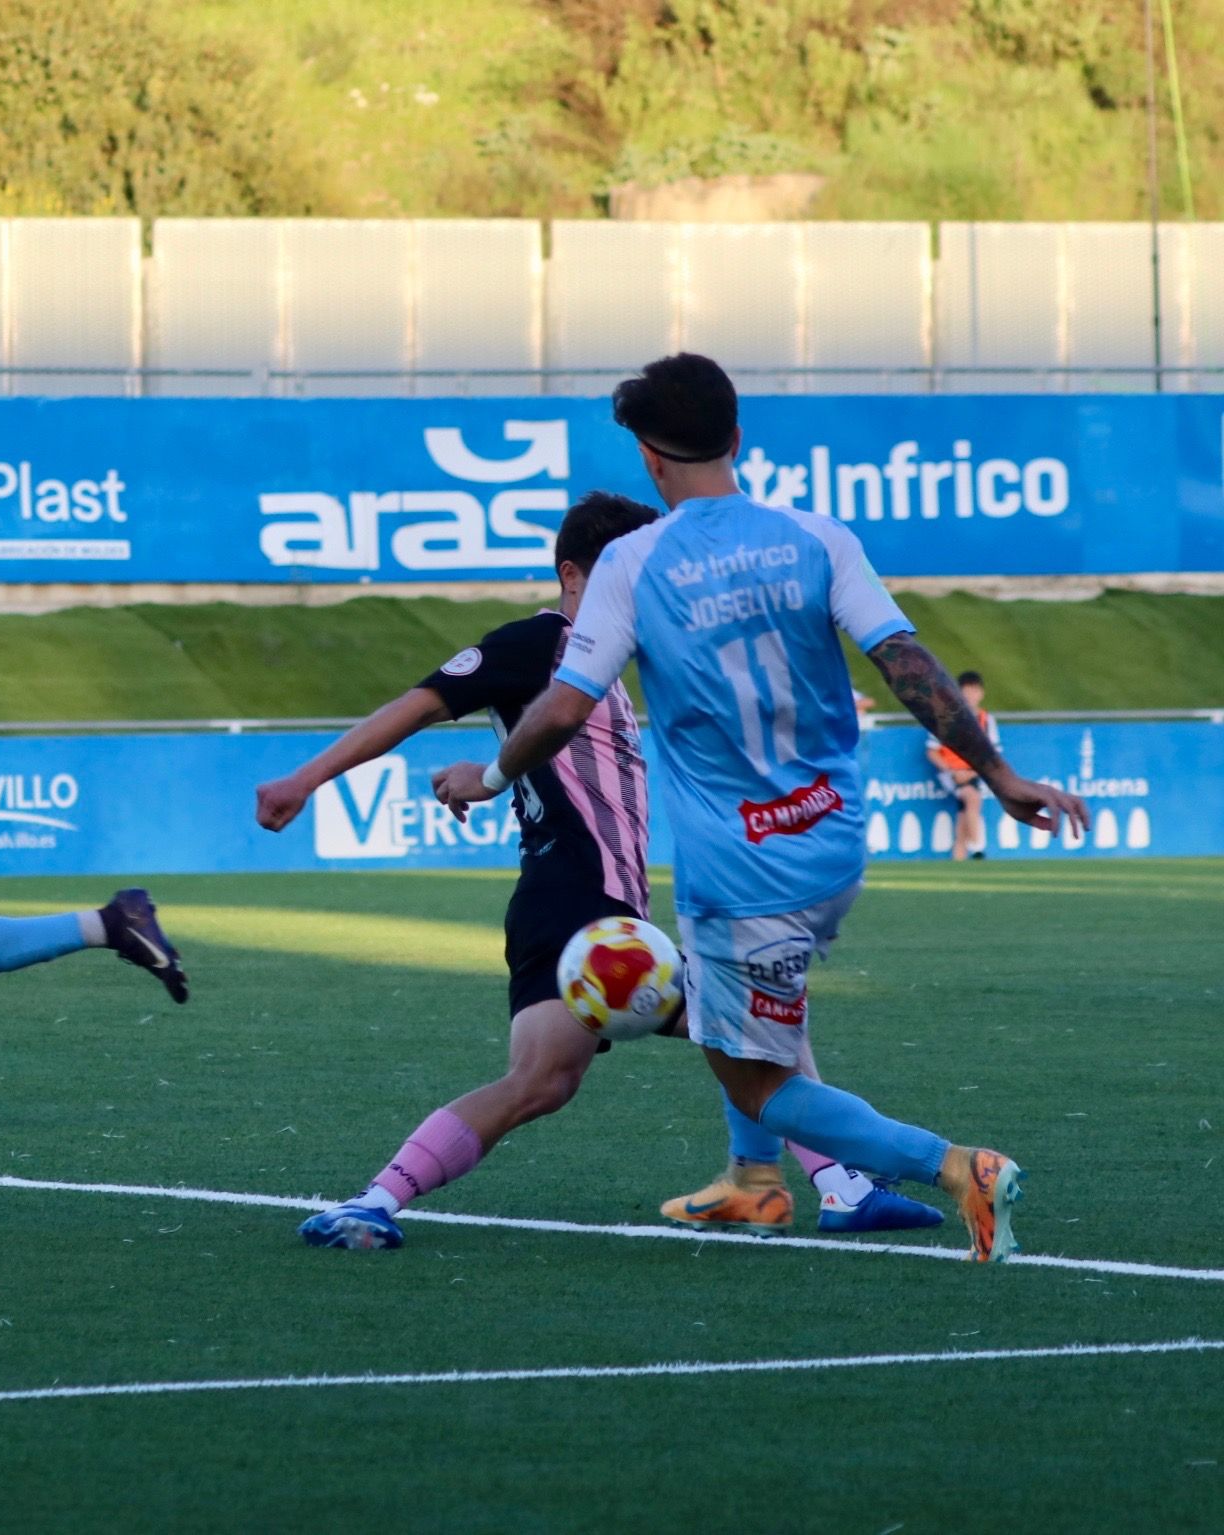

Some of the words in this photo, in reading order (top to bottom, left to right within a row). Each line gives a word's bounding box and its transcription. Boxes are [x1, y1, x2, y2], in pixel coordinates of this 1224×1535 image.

[811, 439, 1070, 522] Infrico
[258, 488, 570, 571] aras
[707, 544, 799, 580] Infrico
[716, 629, 798, 777] 11
[1067, 775, 1149, 798] Lucena
